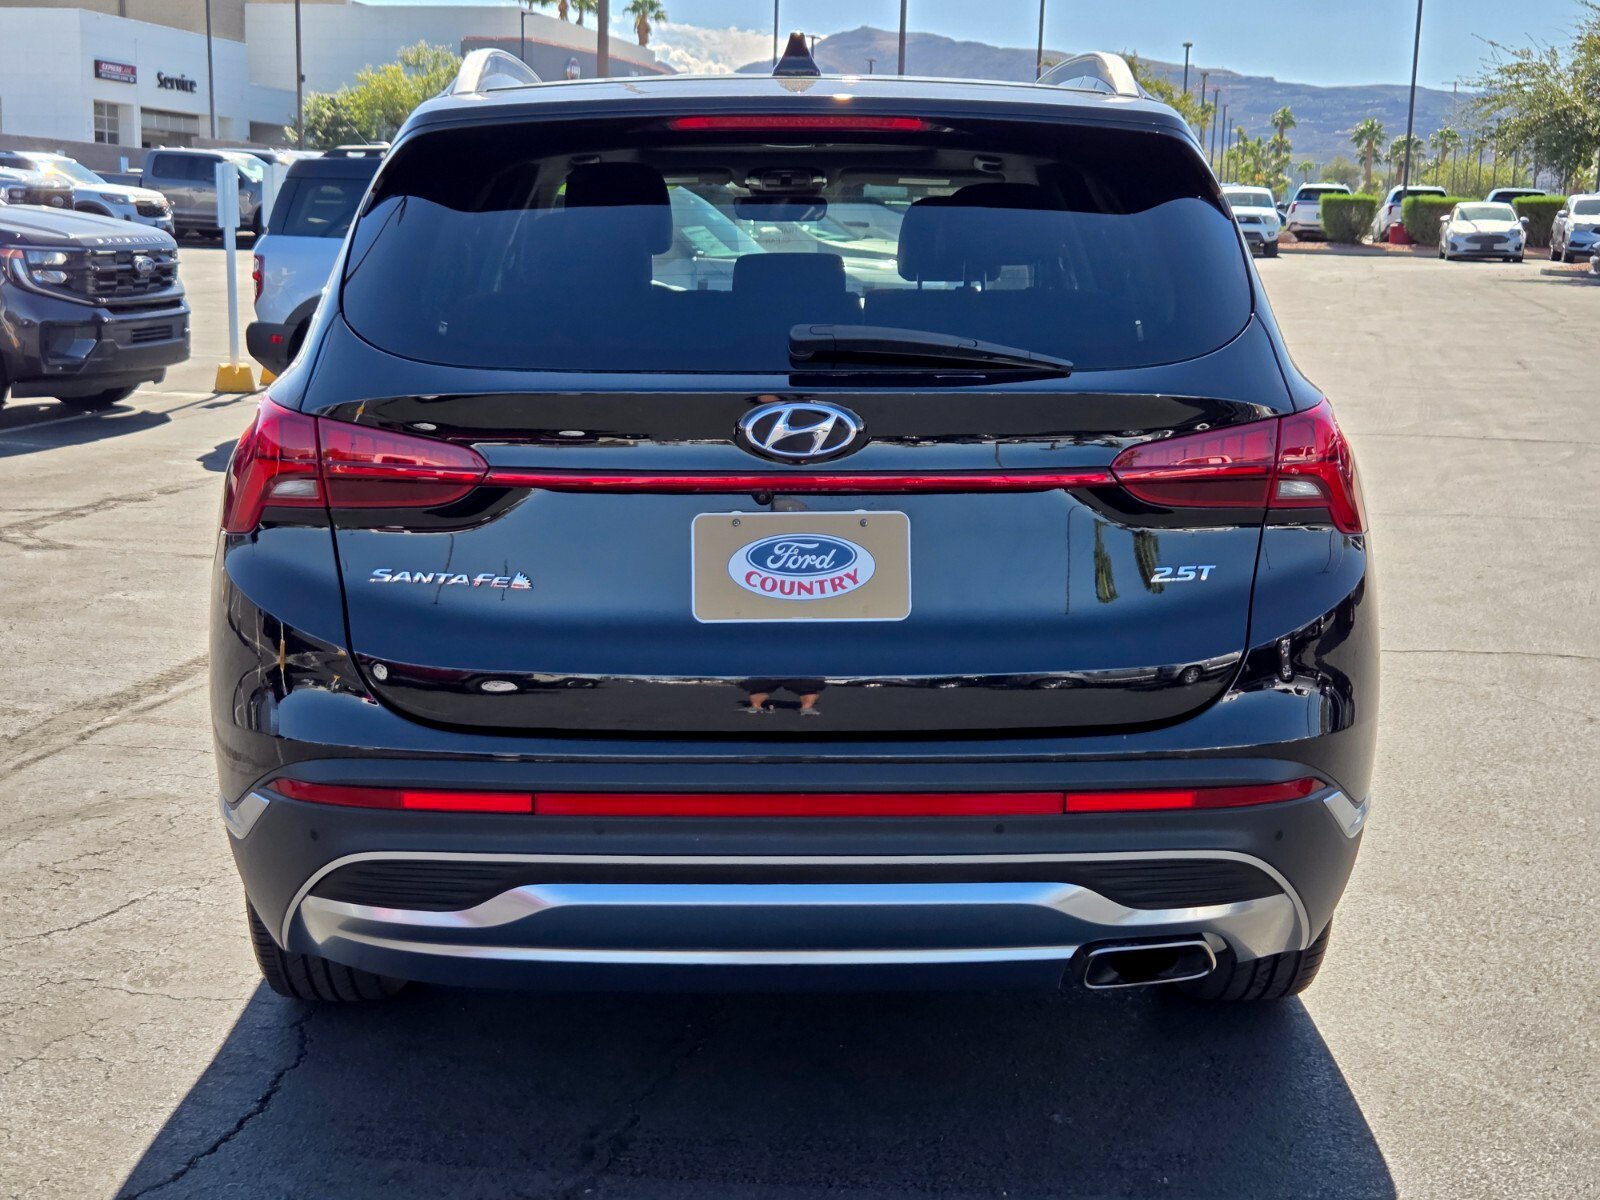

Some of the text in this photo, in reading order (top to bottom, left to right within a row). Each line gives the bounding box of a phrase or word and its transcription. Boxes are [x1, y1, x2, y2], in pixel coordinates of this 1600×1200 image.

[157, 71, 197, 93] Service
[97, 236, 168, 244] EXPEDITIO
[766, 541, 837, 569] Ford
[368, 568, 512, 589] SANTA FE
[745, 568, 859, 596] COUNTRY
[1150, 565, 1217, 583] 2.5T
